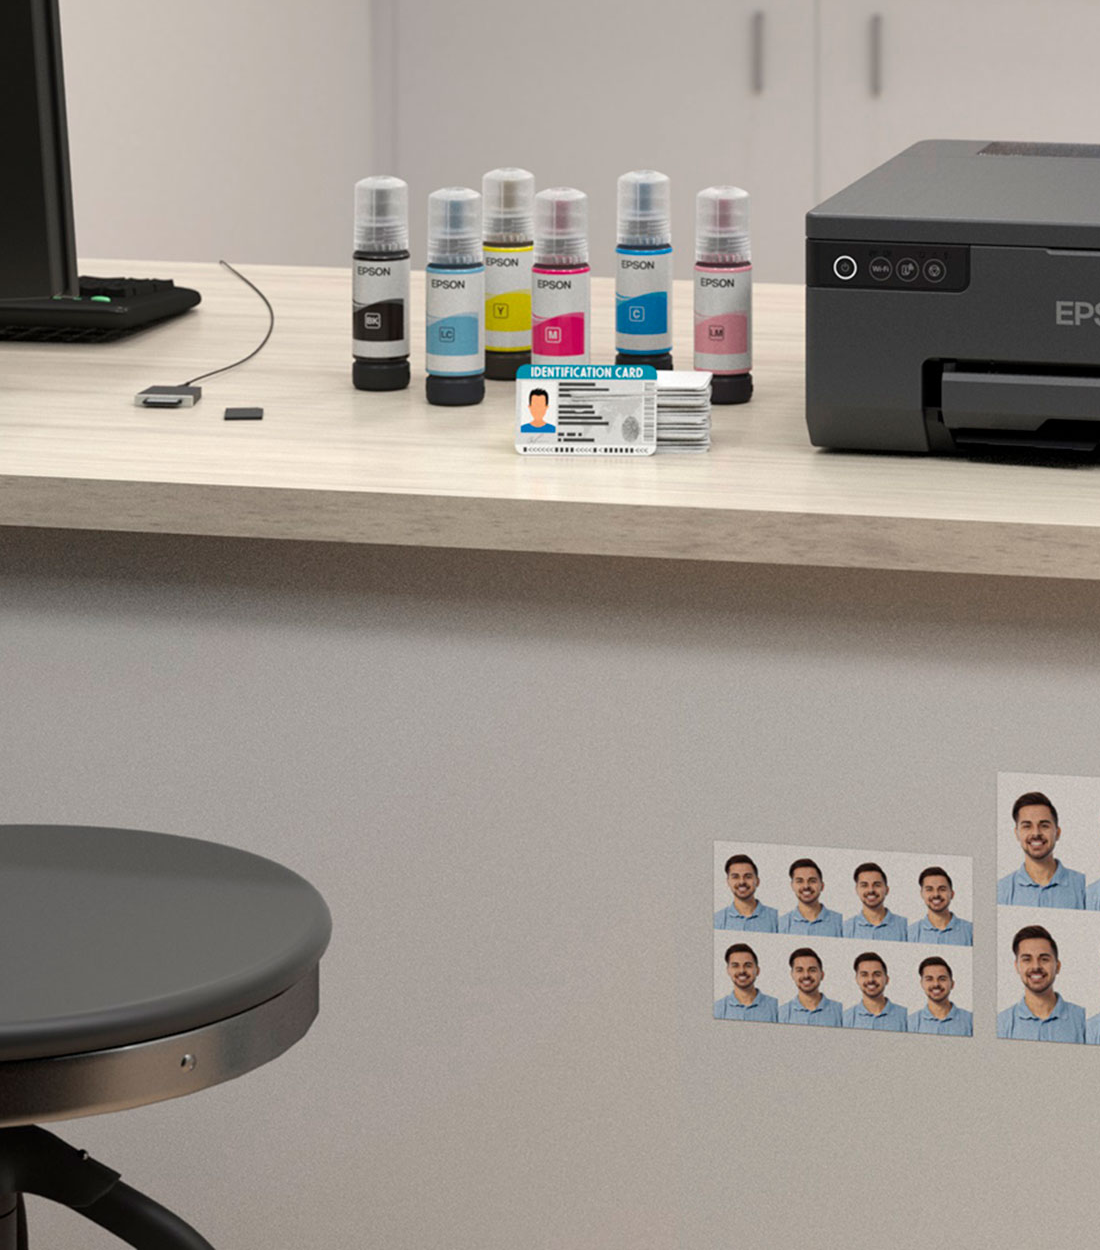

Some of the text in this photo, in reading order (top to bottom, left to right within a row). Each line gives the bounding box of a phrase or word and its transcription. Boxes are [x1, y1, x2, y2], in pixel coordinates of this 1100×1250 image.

[486, 257, 519, 267] EPSON
[621, 260, 655, 270] EPSON
[357, 266, 391, 276] EPSON
[431, 279, 465, 289] EPSON
[537, 279, 572, 290] EPSON
[700, 277, 735, 288] EPSON
[530, 366, 644, 378] IDENTIFICATION CARD
